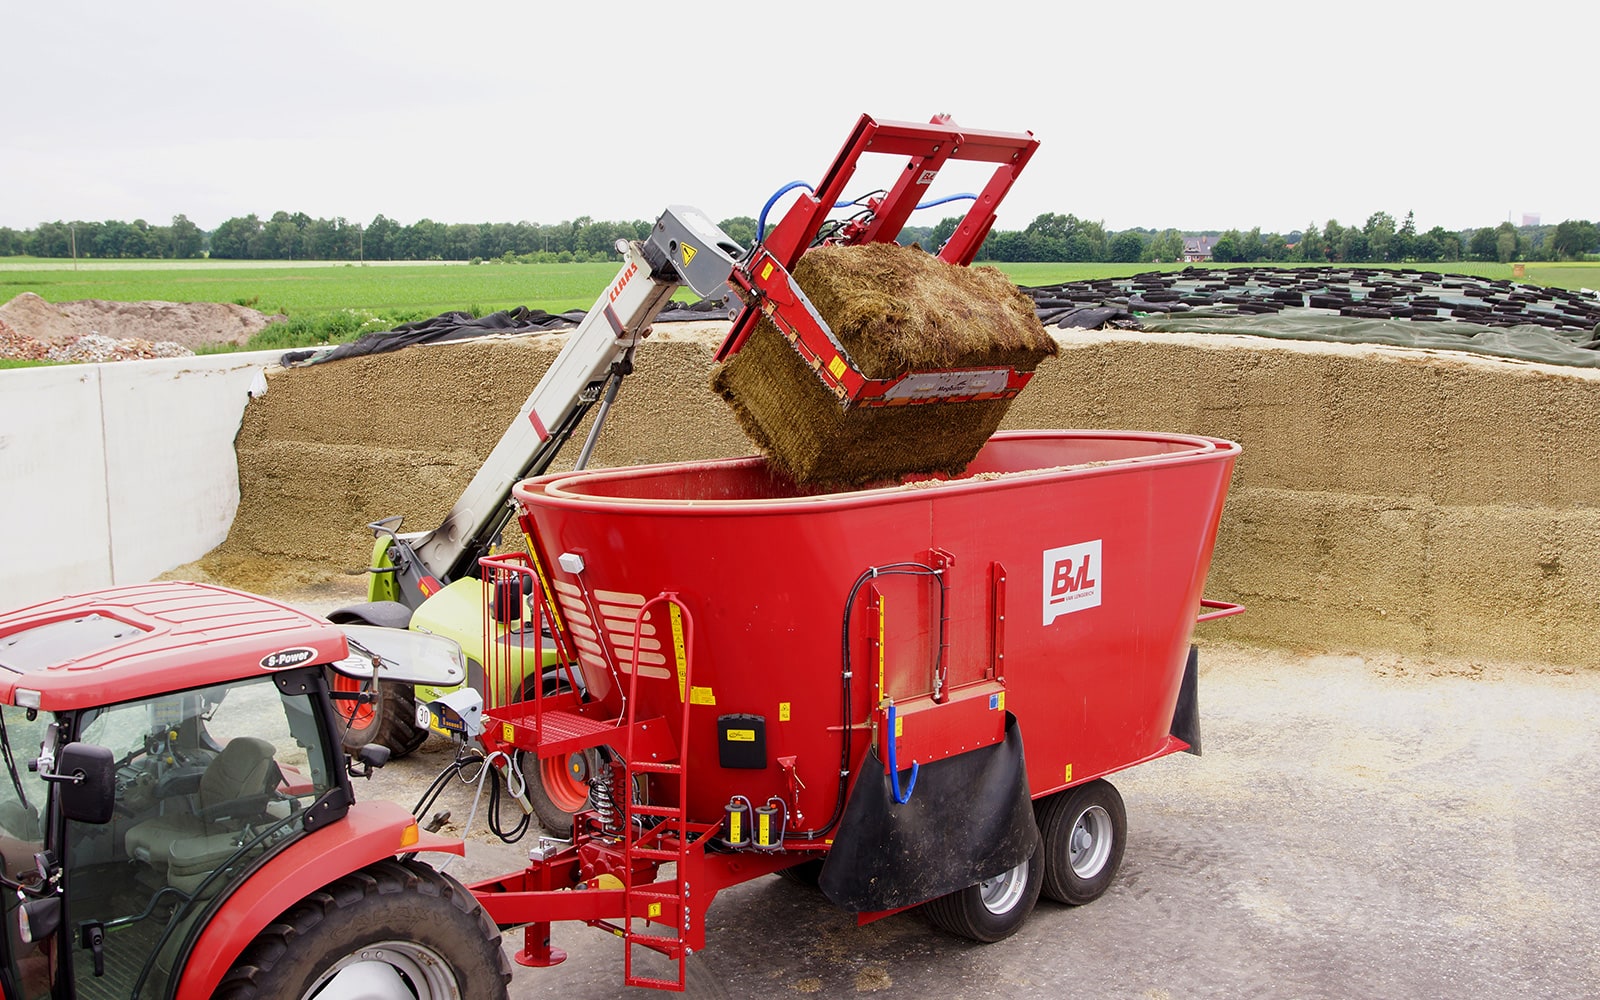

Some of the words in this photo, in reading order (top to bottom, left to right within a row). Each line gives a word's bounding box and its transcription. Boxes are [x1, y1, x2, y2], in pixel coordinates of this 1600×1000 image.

[609, 261, 638, 303] CLAAS
[1050, 554, 1096, 597] BvL
[419, 707, 429, 725] 30
